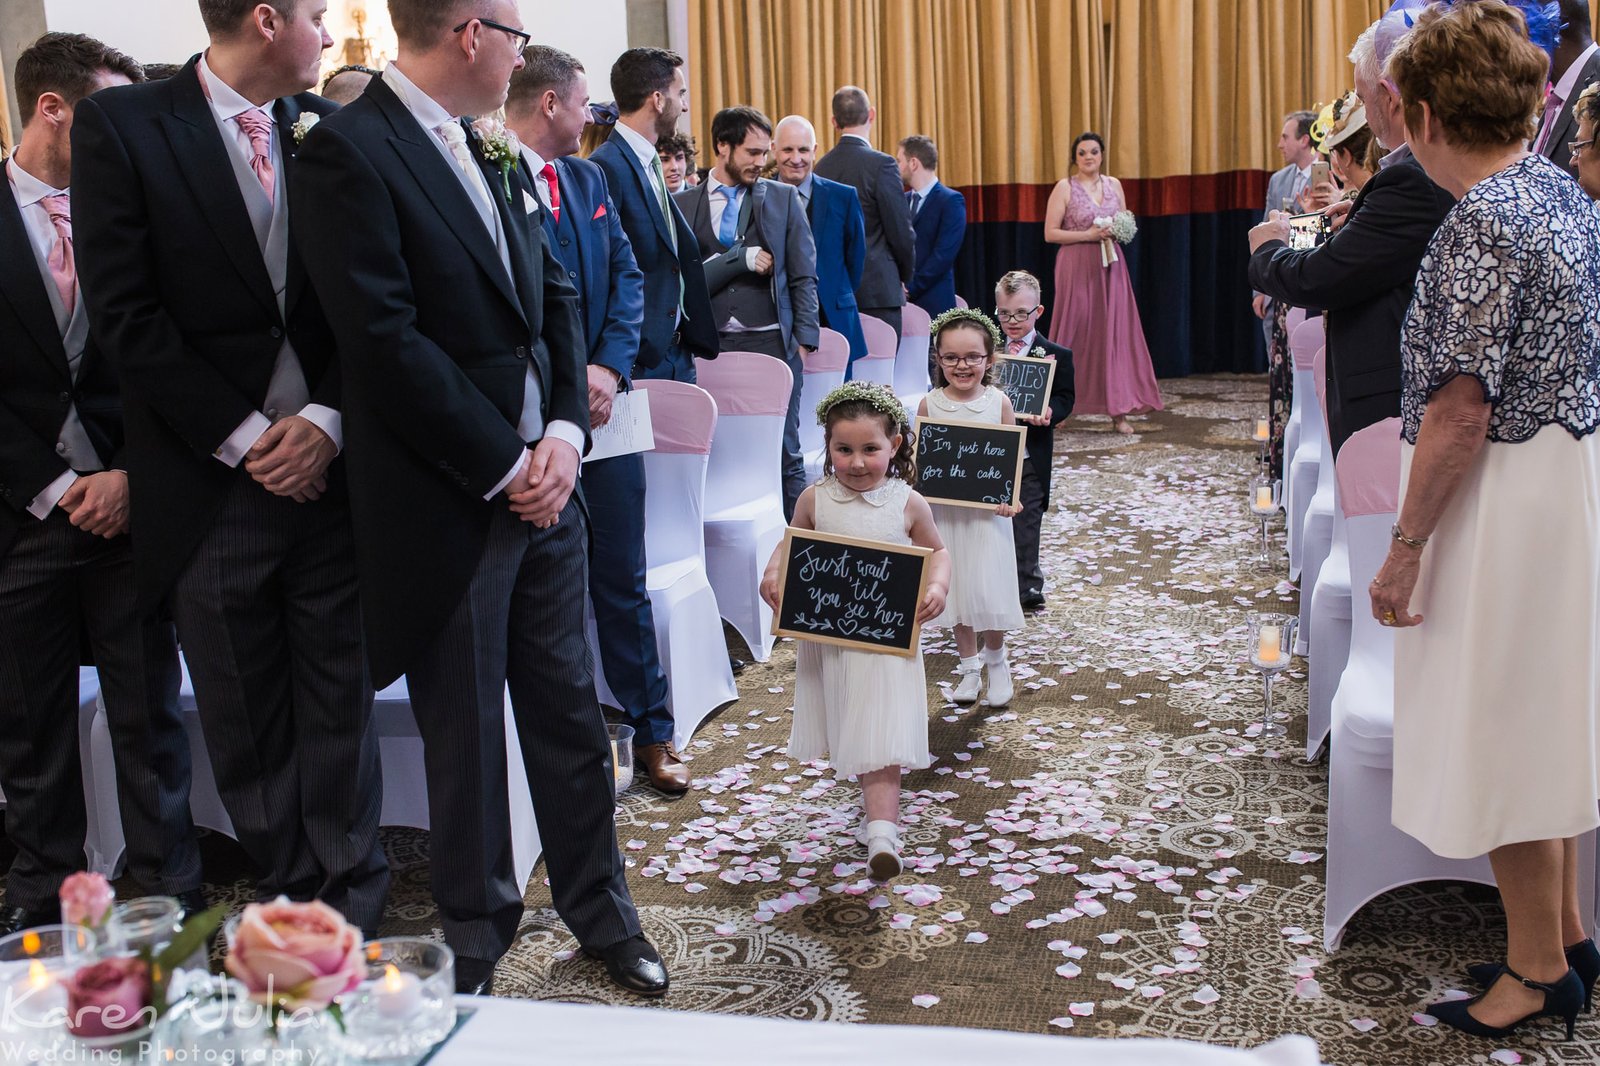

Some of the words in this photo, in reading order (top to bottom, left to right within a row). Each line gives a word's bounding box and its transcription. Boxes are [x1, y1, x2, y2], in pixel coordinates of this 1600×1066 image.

[1009, 392, 1035, 414] GLE
[957, 441, 979, 459] just
[983, 441, 1006, 456] here
[922, 465, 943, 481] for
[950, 464, 967, 478] the
[977, 466, 1002, 480] cake
[794, 545, 851, 582] Just
[856, 557, 893, 582] wait
[808, 587, 842, 614] you
[844, 602, 870, 619] see
[874, 597, 905, 627] her
